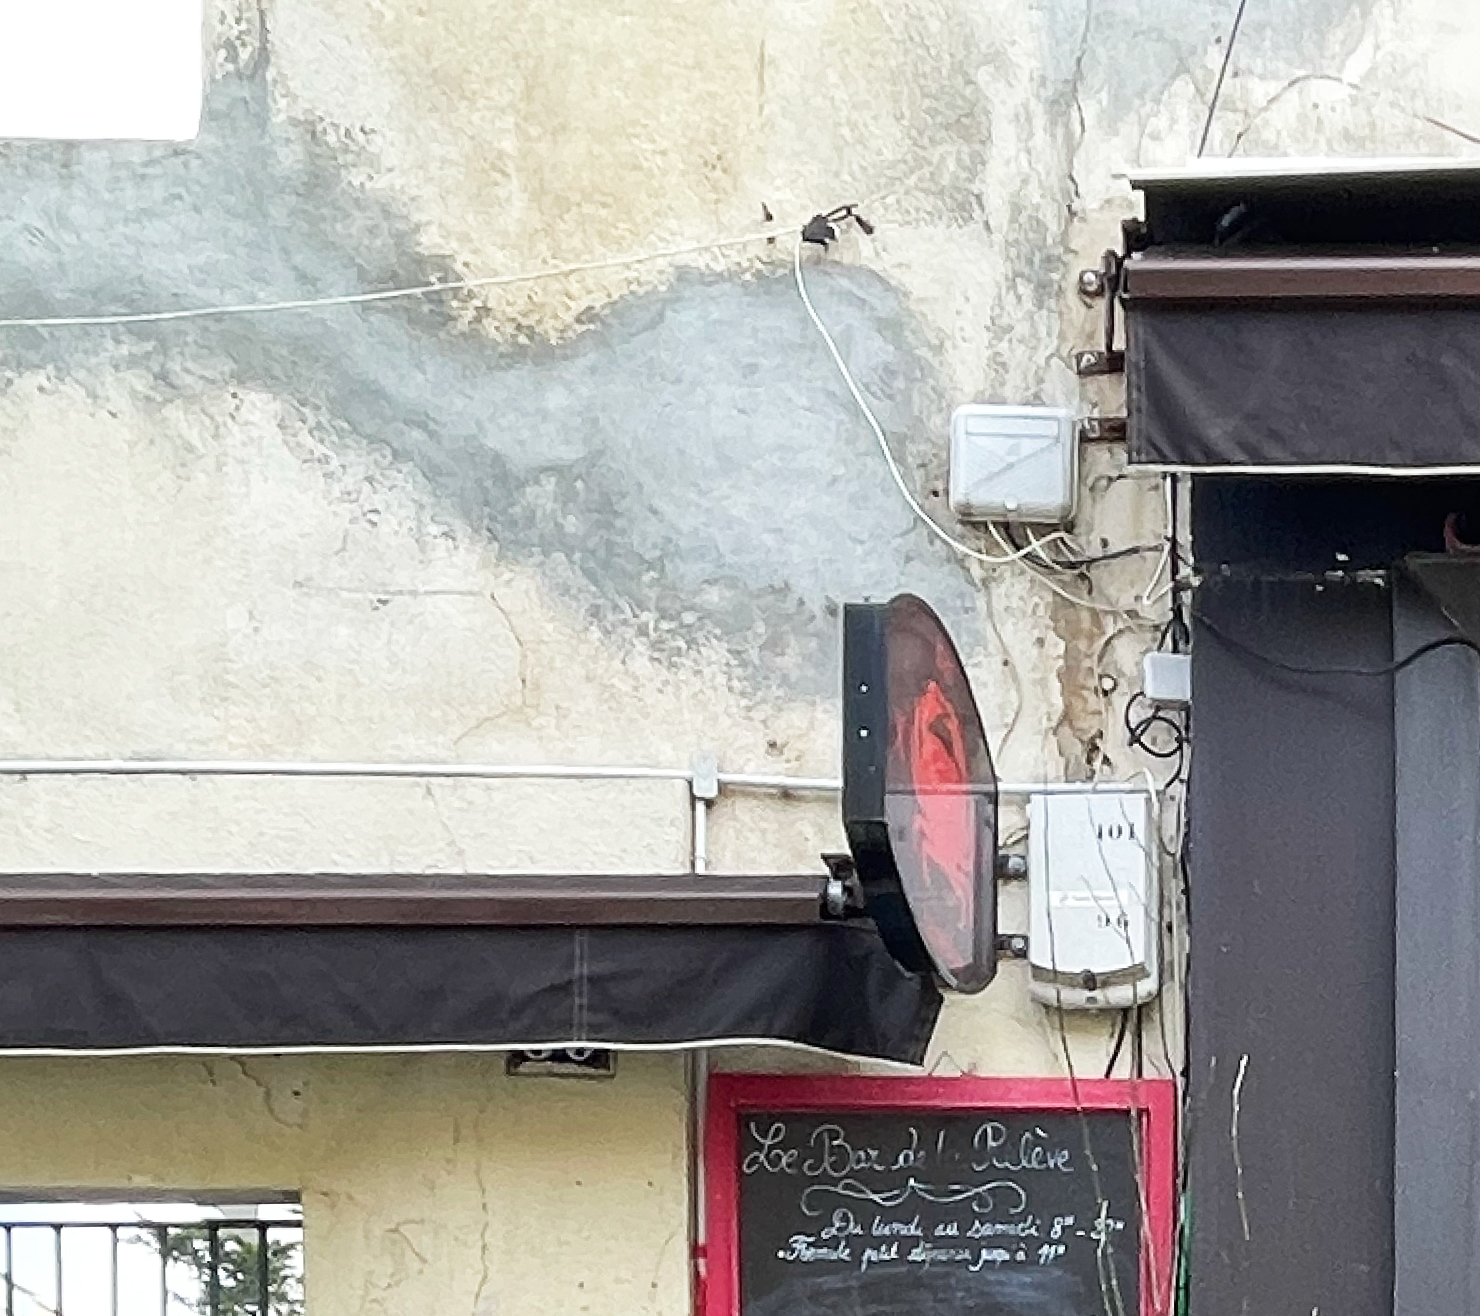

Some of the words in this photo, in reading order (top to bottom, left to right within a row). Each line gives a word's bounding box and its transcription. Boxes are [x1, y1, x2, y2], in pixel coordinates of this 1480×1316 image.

[1097, 823, 1135, 840] 101
[742, 1122, 798, 1174] Le
[803, 1124, 886, 1177] Bar
